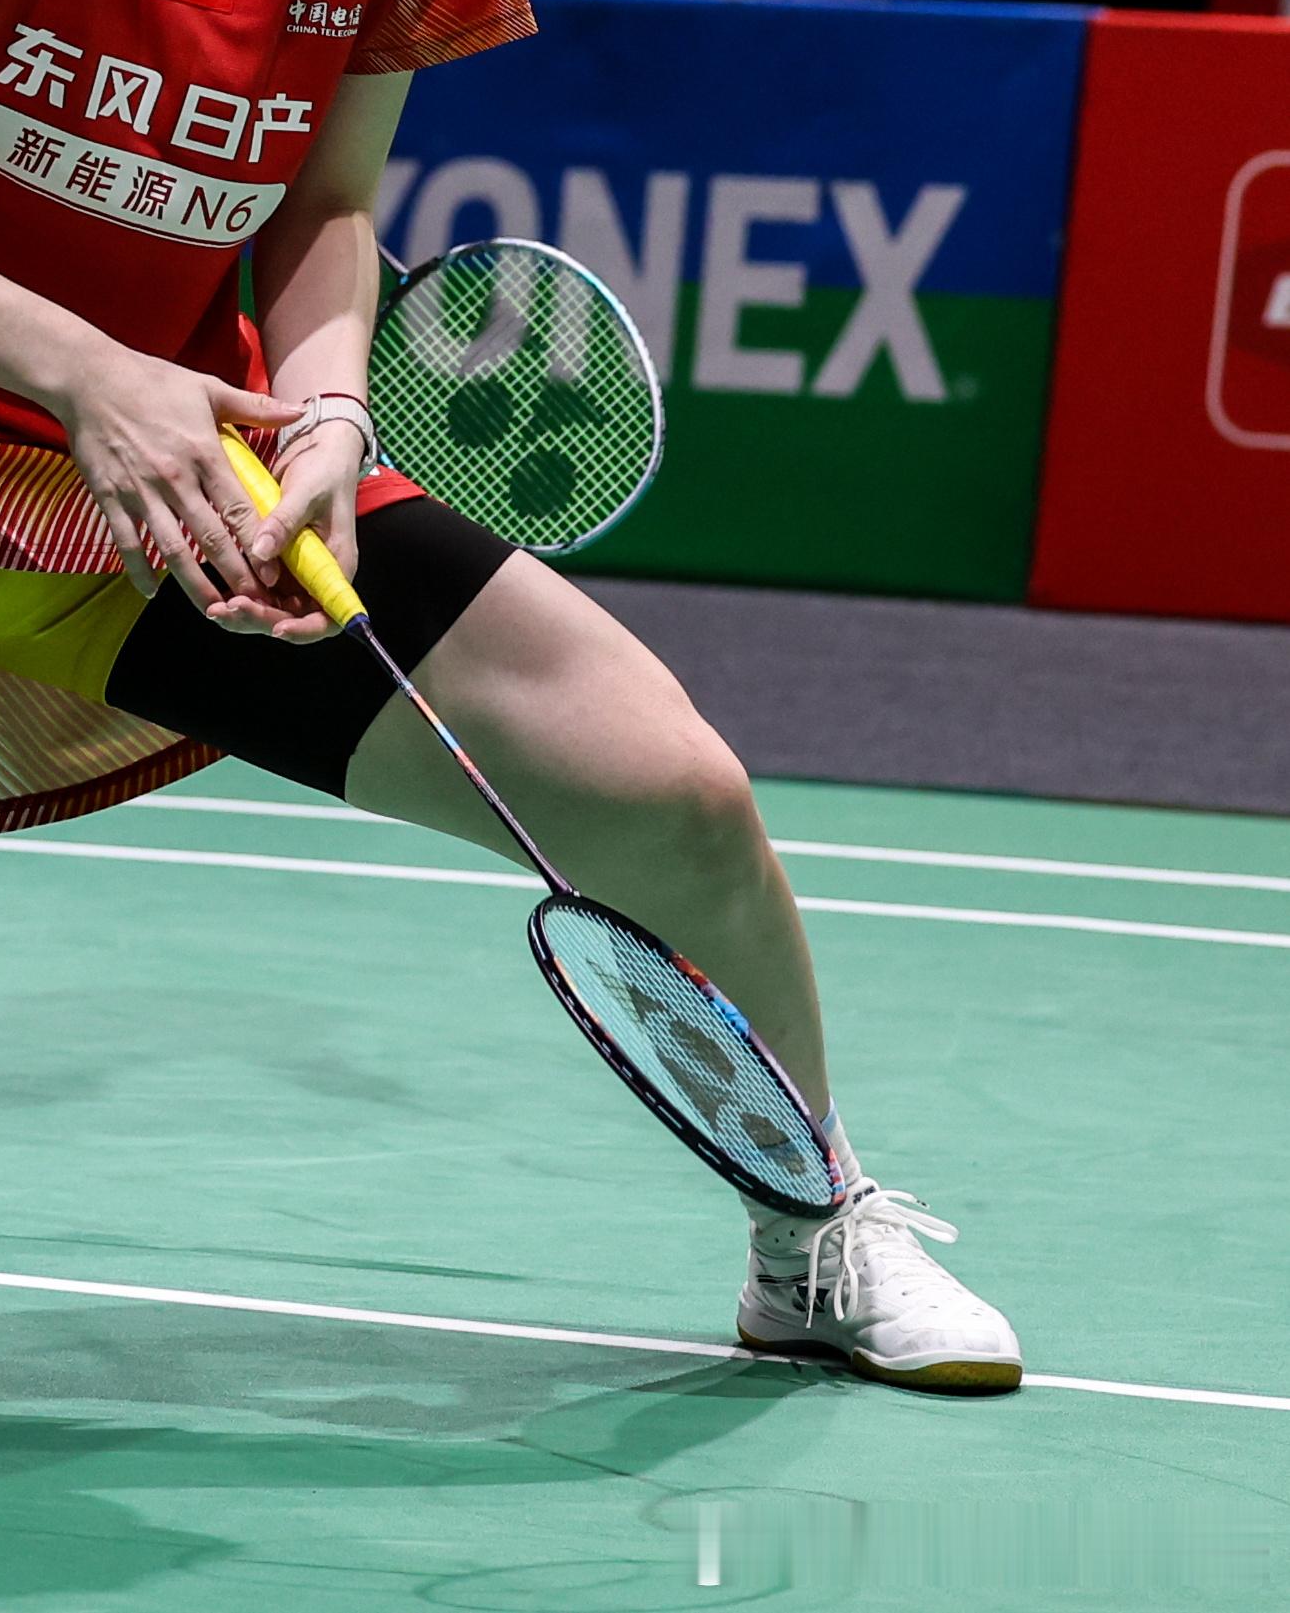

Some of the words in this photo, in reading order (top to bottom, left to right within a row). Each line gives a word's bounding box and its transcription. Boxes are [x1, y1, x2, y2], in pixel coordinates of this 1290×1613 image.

[288, 0, 362, 27] 中国电信
[287, 24, 317, 35] CHINA
[6, 128, 258, 233] 新能源N6
